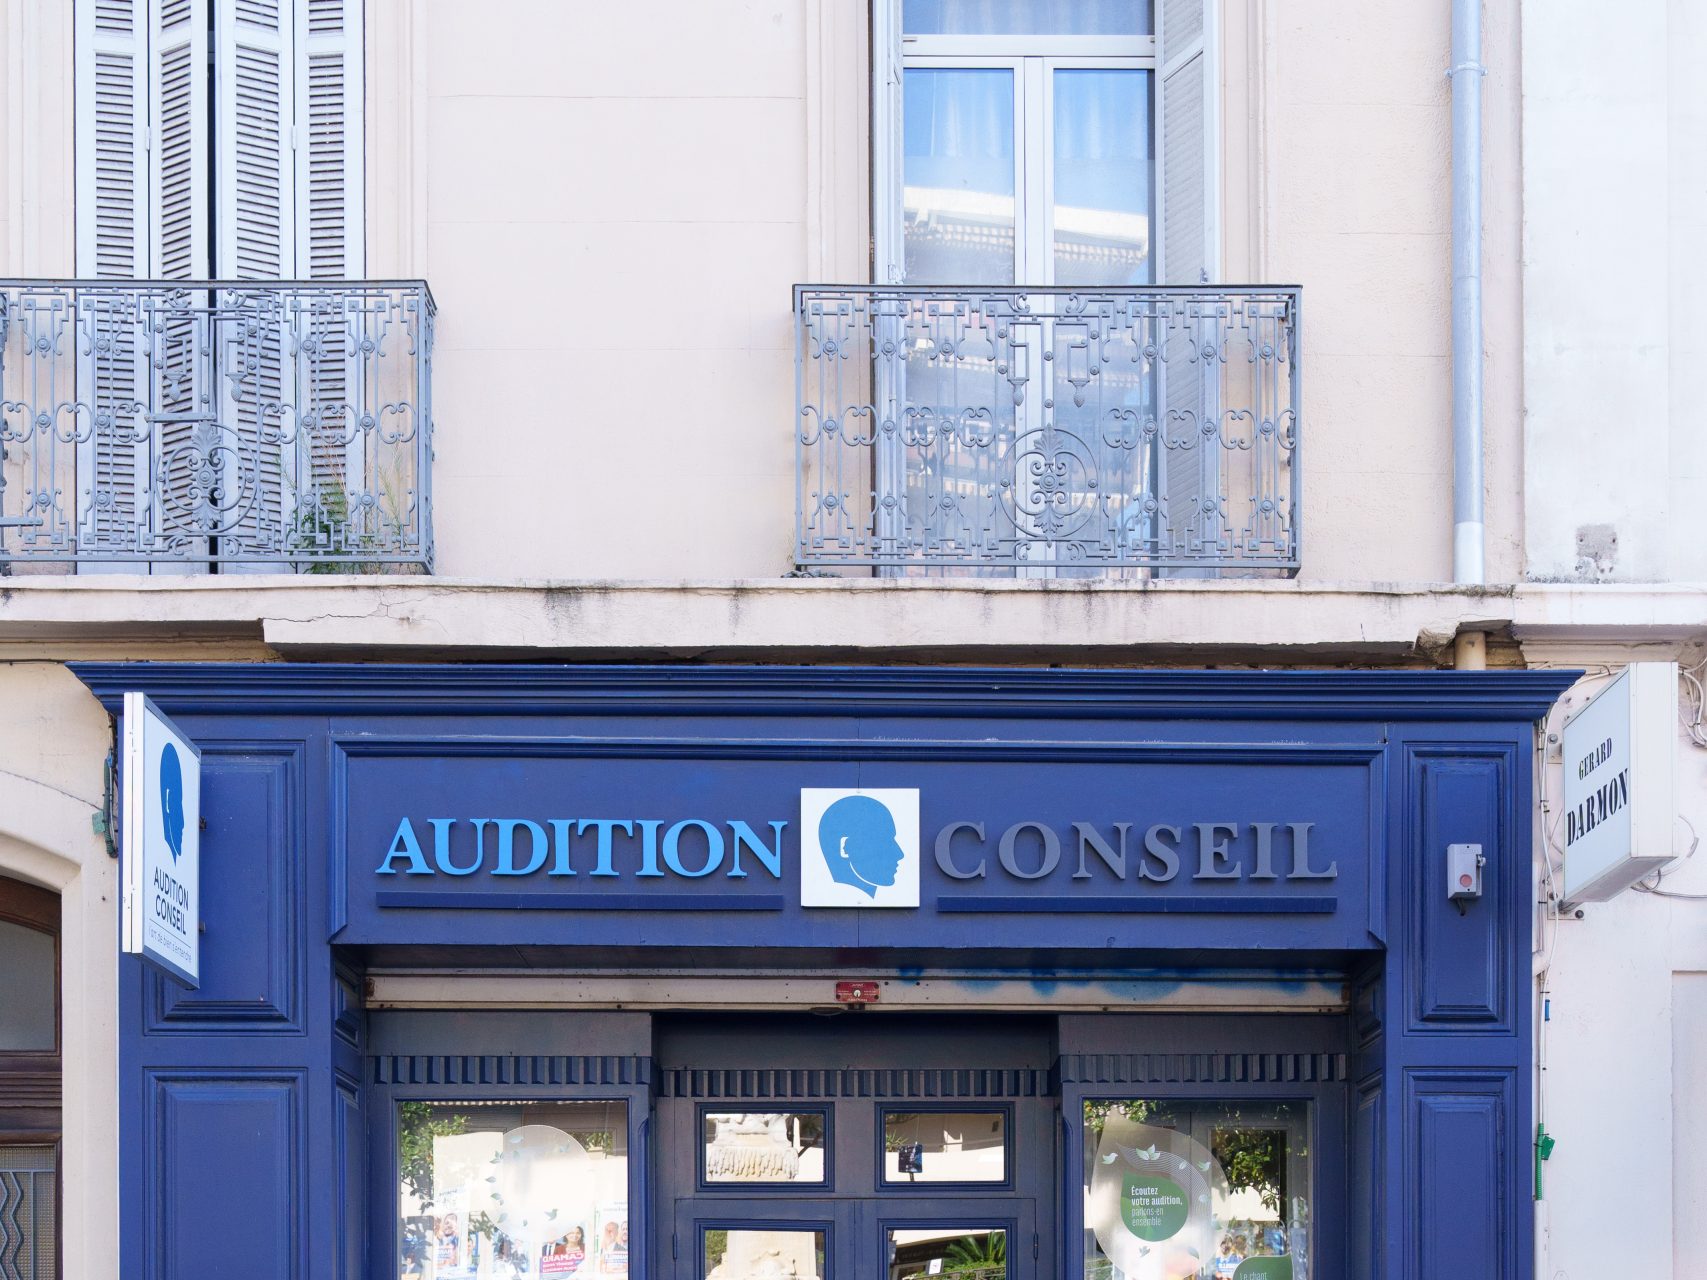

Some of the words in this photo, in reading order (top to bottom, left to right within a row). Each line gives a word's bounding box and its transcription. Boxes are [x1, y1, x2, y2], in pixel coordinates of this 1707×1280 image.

[1578, 738, 1612, 780] GERARD
[1567, 768, 1628, 847] DARMON
[376, 818, 789, 878] AUDITION
[934, 821, 1338, 881] CONSEIL
[153, 866, 189, 911] AUDITION
[155, 894, 187, 935] CONSEIL
[1131, 1185, 1158, 1195] Écoutez
[1131, 1197, 1150, 1206] votre
[1151, 1195, 1183, 1206] audition,
[1131, 1207, 1164, 1217] parlons-en
[1132, 1216, 1162, 1226] ensemble
